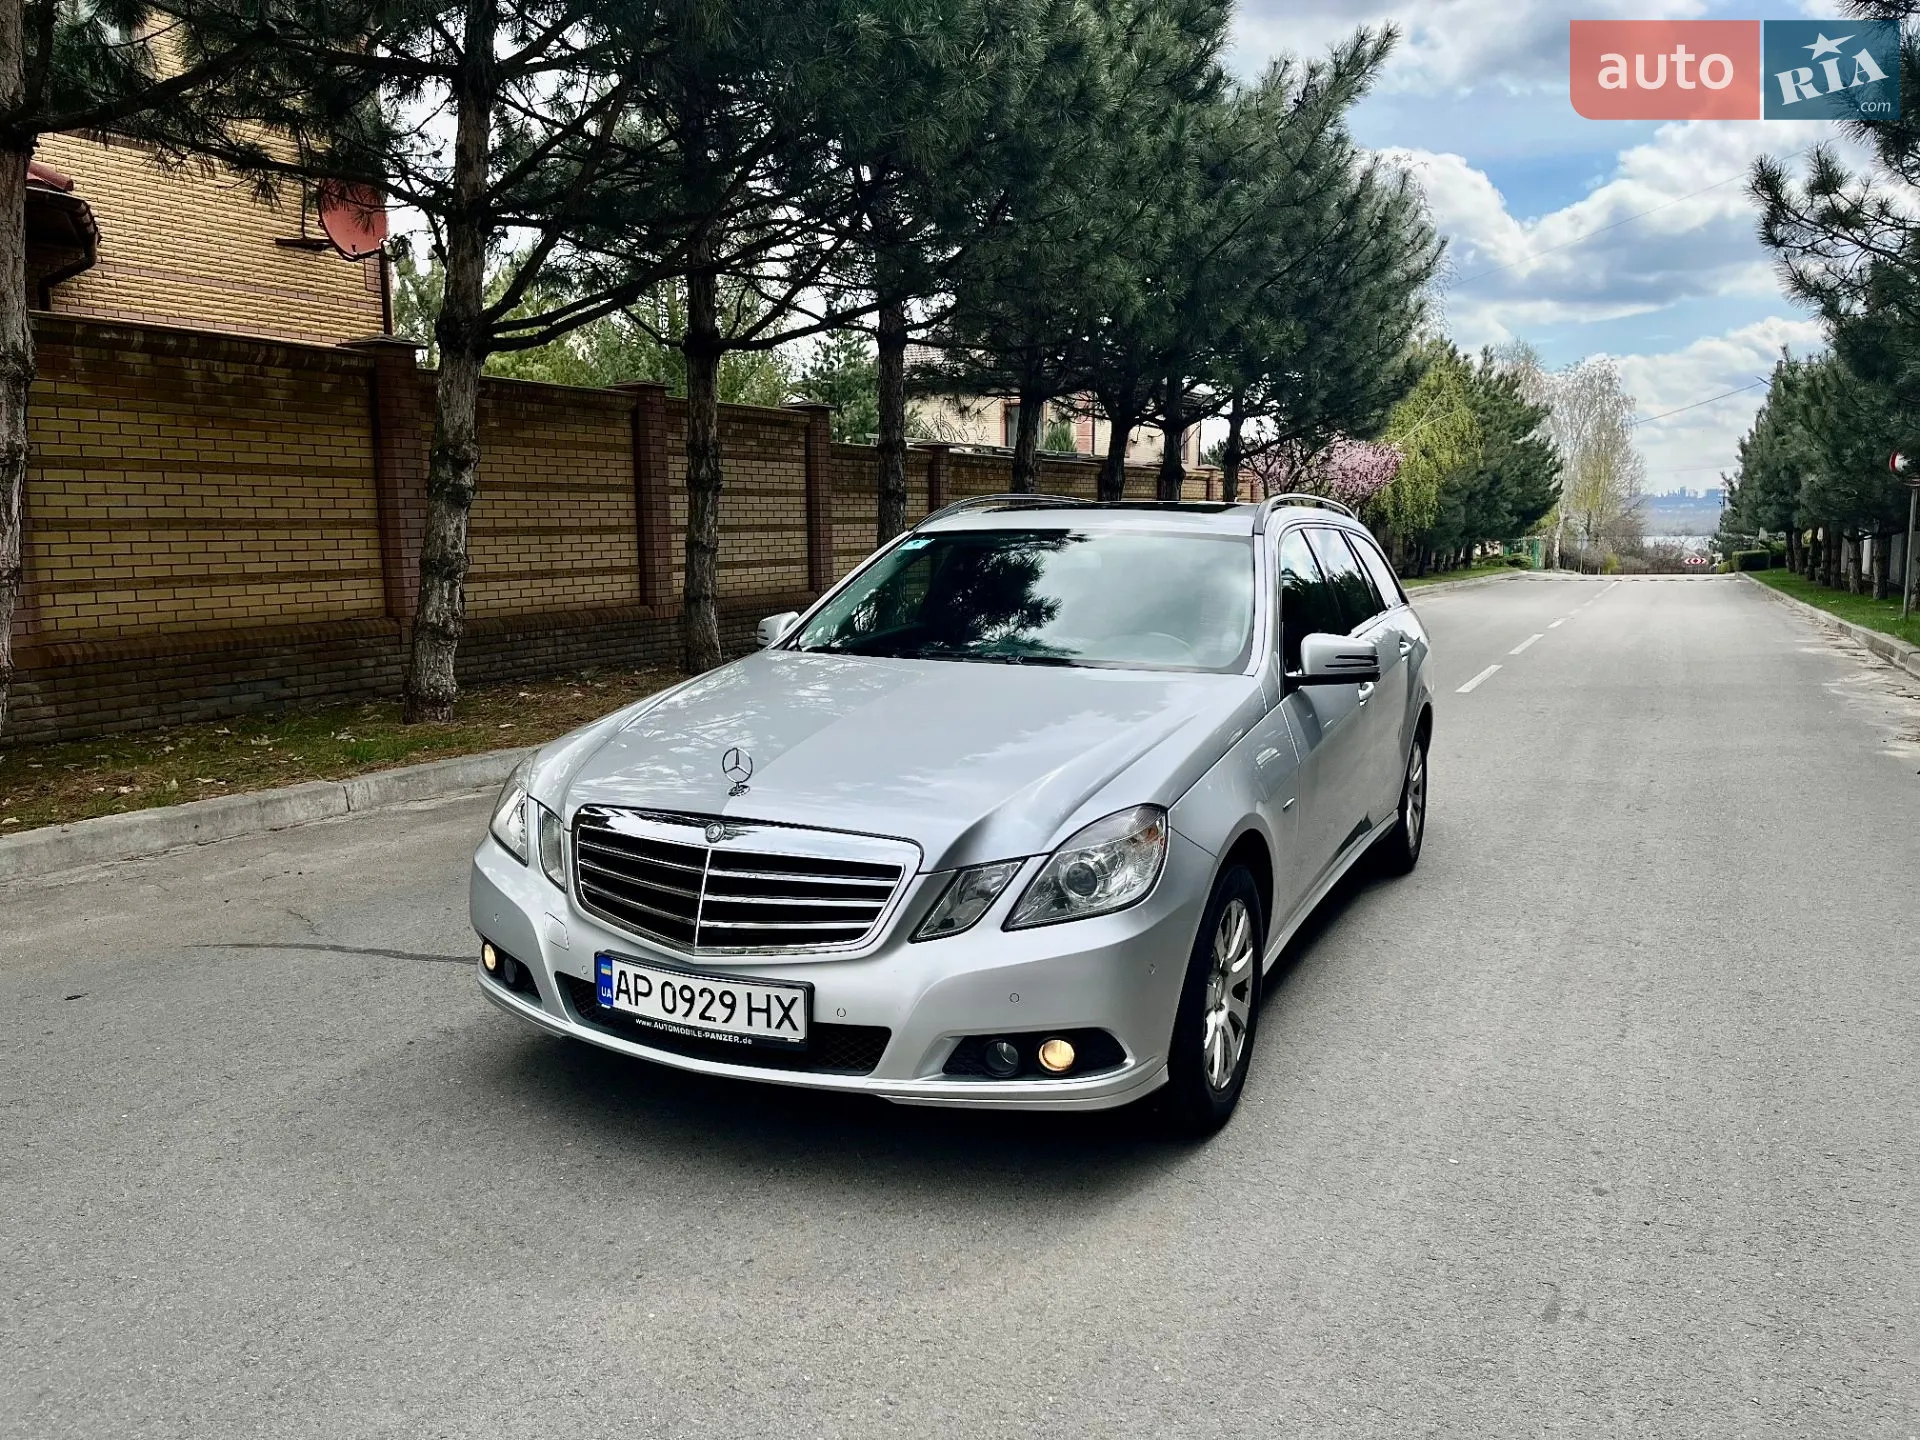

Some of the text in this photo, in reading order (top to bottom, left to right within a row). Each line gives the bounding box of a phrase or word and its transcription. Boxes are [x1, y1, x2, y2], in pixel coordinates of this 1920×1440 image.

[601, 986, 612, 999] UA
[615, 970, 799, 1032] AP 0929 HX
[635, 1017, 753, 1045] www.AUTOMOBILE-PANZER.de
